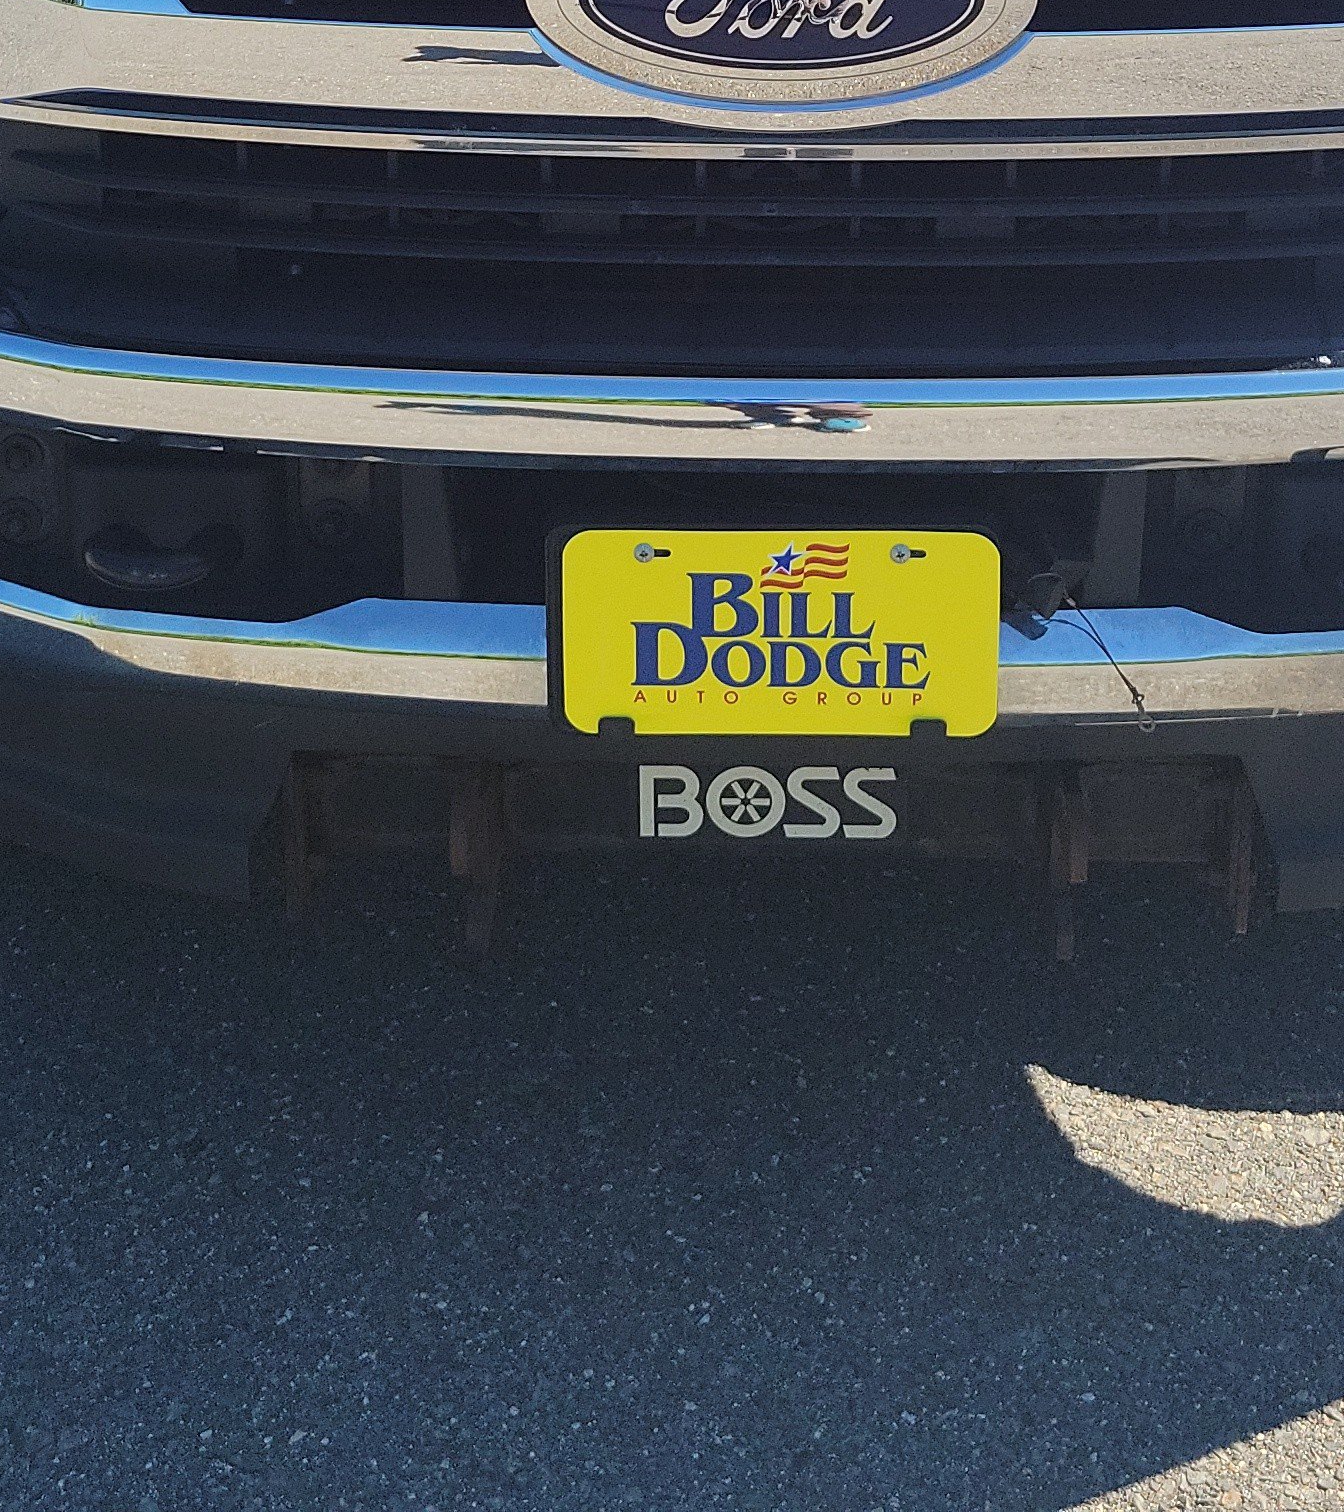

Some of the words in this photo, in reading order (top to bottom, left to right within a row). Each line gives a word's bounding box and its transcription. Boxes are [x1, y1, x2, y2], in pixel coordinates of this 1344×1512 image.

[688, 573, 875, 638] BILL
[631, 622, 931, 690] DODGE
[634, 690, 739, 705] AUTO
[782, 690, 925, 706] GROUP
[639, 765, 898, 838] BOSS
